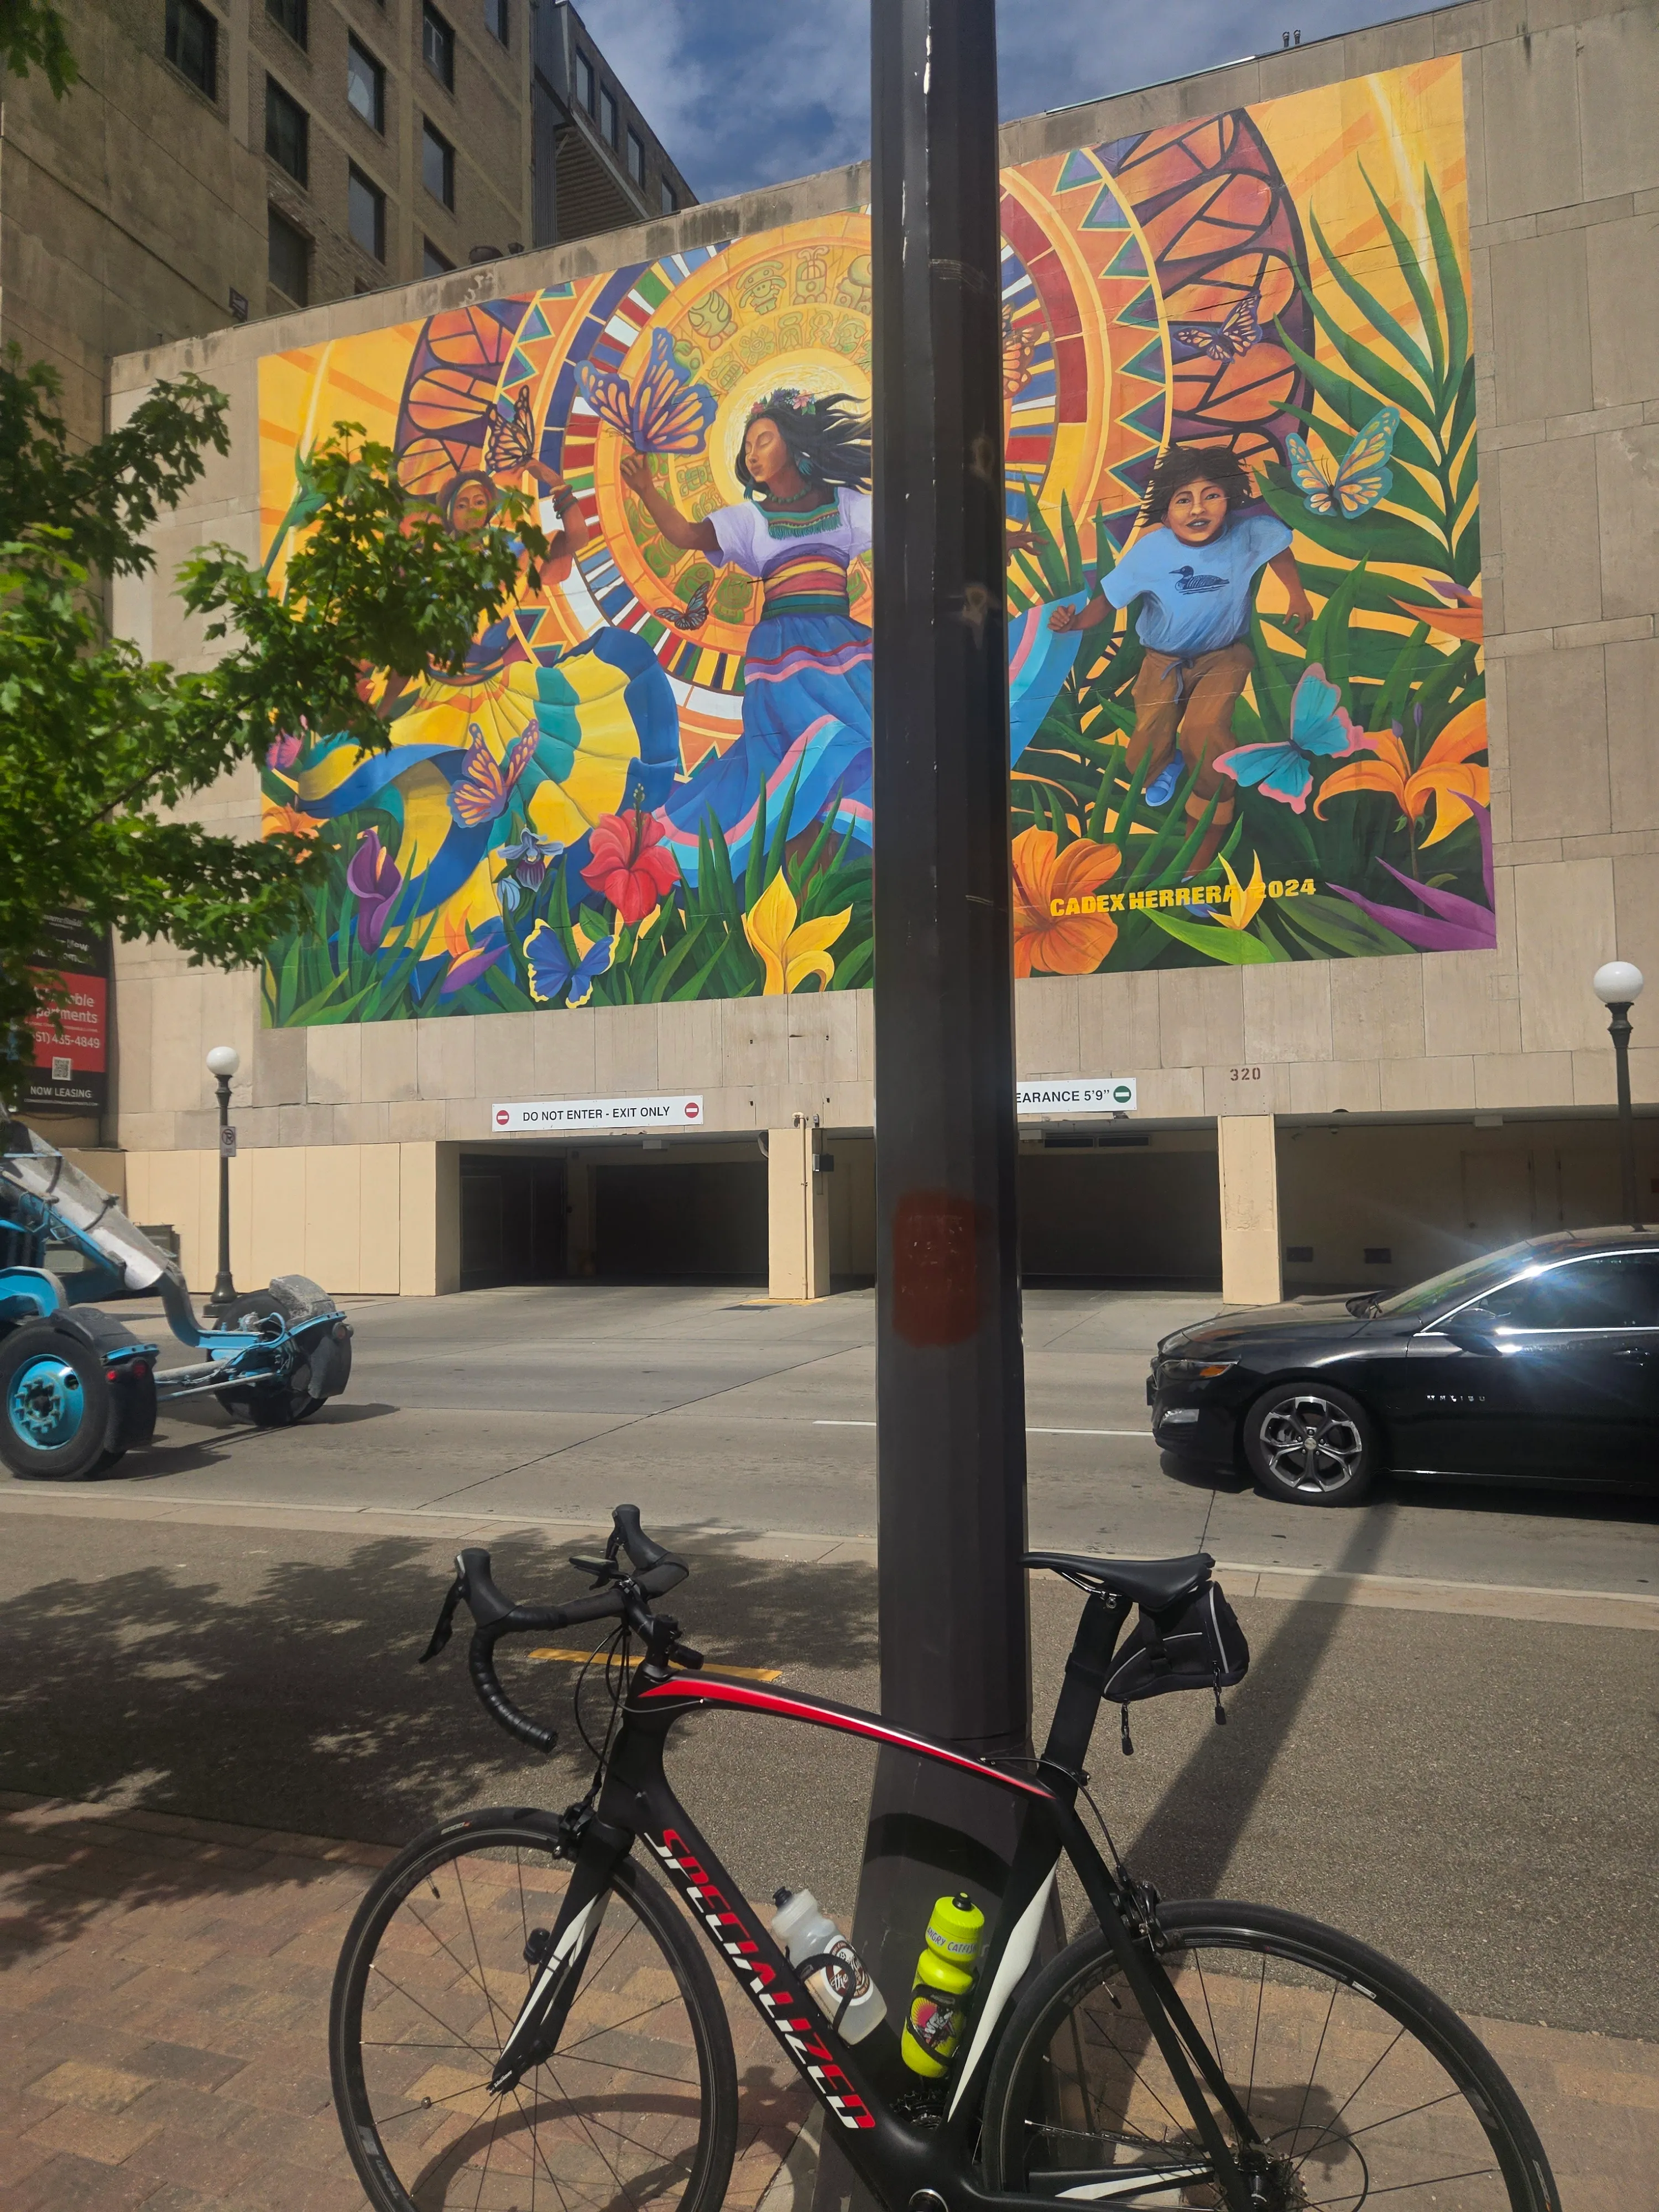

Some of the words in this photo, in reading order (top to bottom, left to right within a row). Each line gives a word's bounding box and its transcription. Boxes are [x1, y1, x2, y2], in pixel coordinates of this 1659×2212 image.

[1050, 893, 1125, 917] CADEX
[1129, 884, 1239, 910] HERRERA
[1230, 1067, 1260, 1081] 320
[30, 1086, 51, 1095] NOW
[55, 1087, 92, 1098] LEASING
[523, 1112, 538, 1121] DO
[541, 1110, 564, 1121] NOT
[567, 1109, 602, 1120] ENTER
[613, 1108, 637, 1118] EXIT
[640, 1106, 670, 1117] ONLY
[927, 1927, 946, 1946] ANGRY
[644, 1829, 875, 2128] SPECIALIZED
[830, 1973, 848, 1991] the
